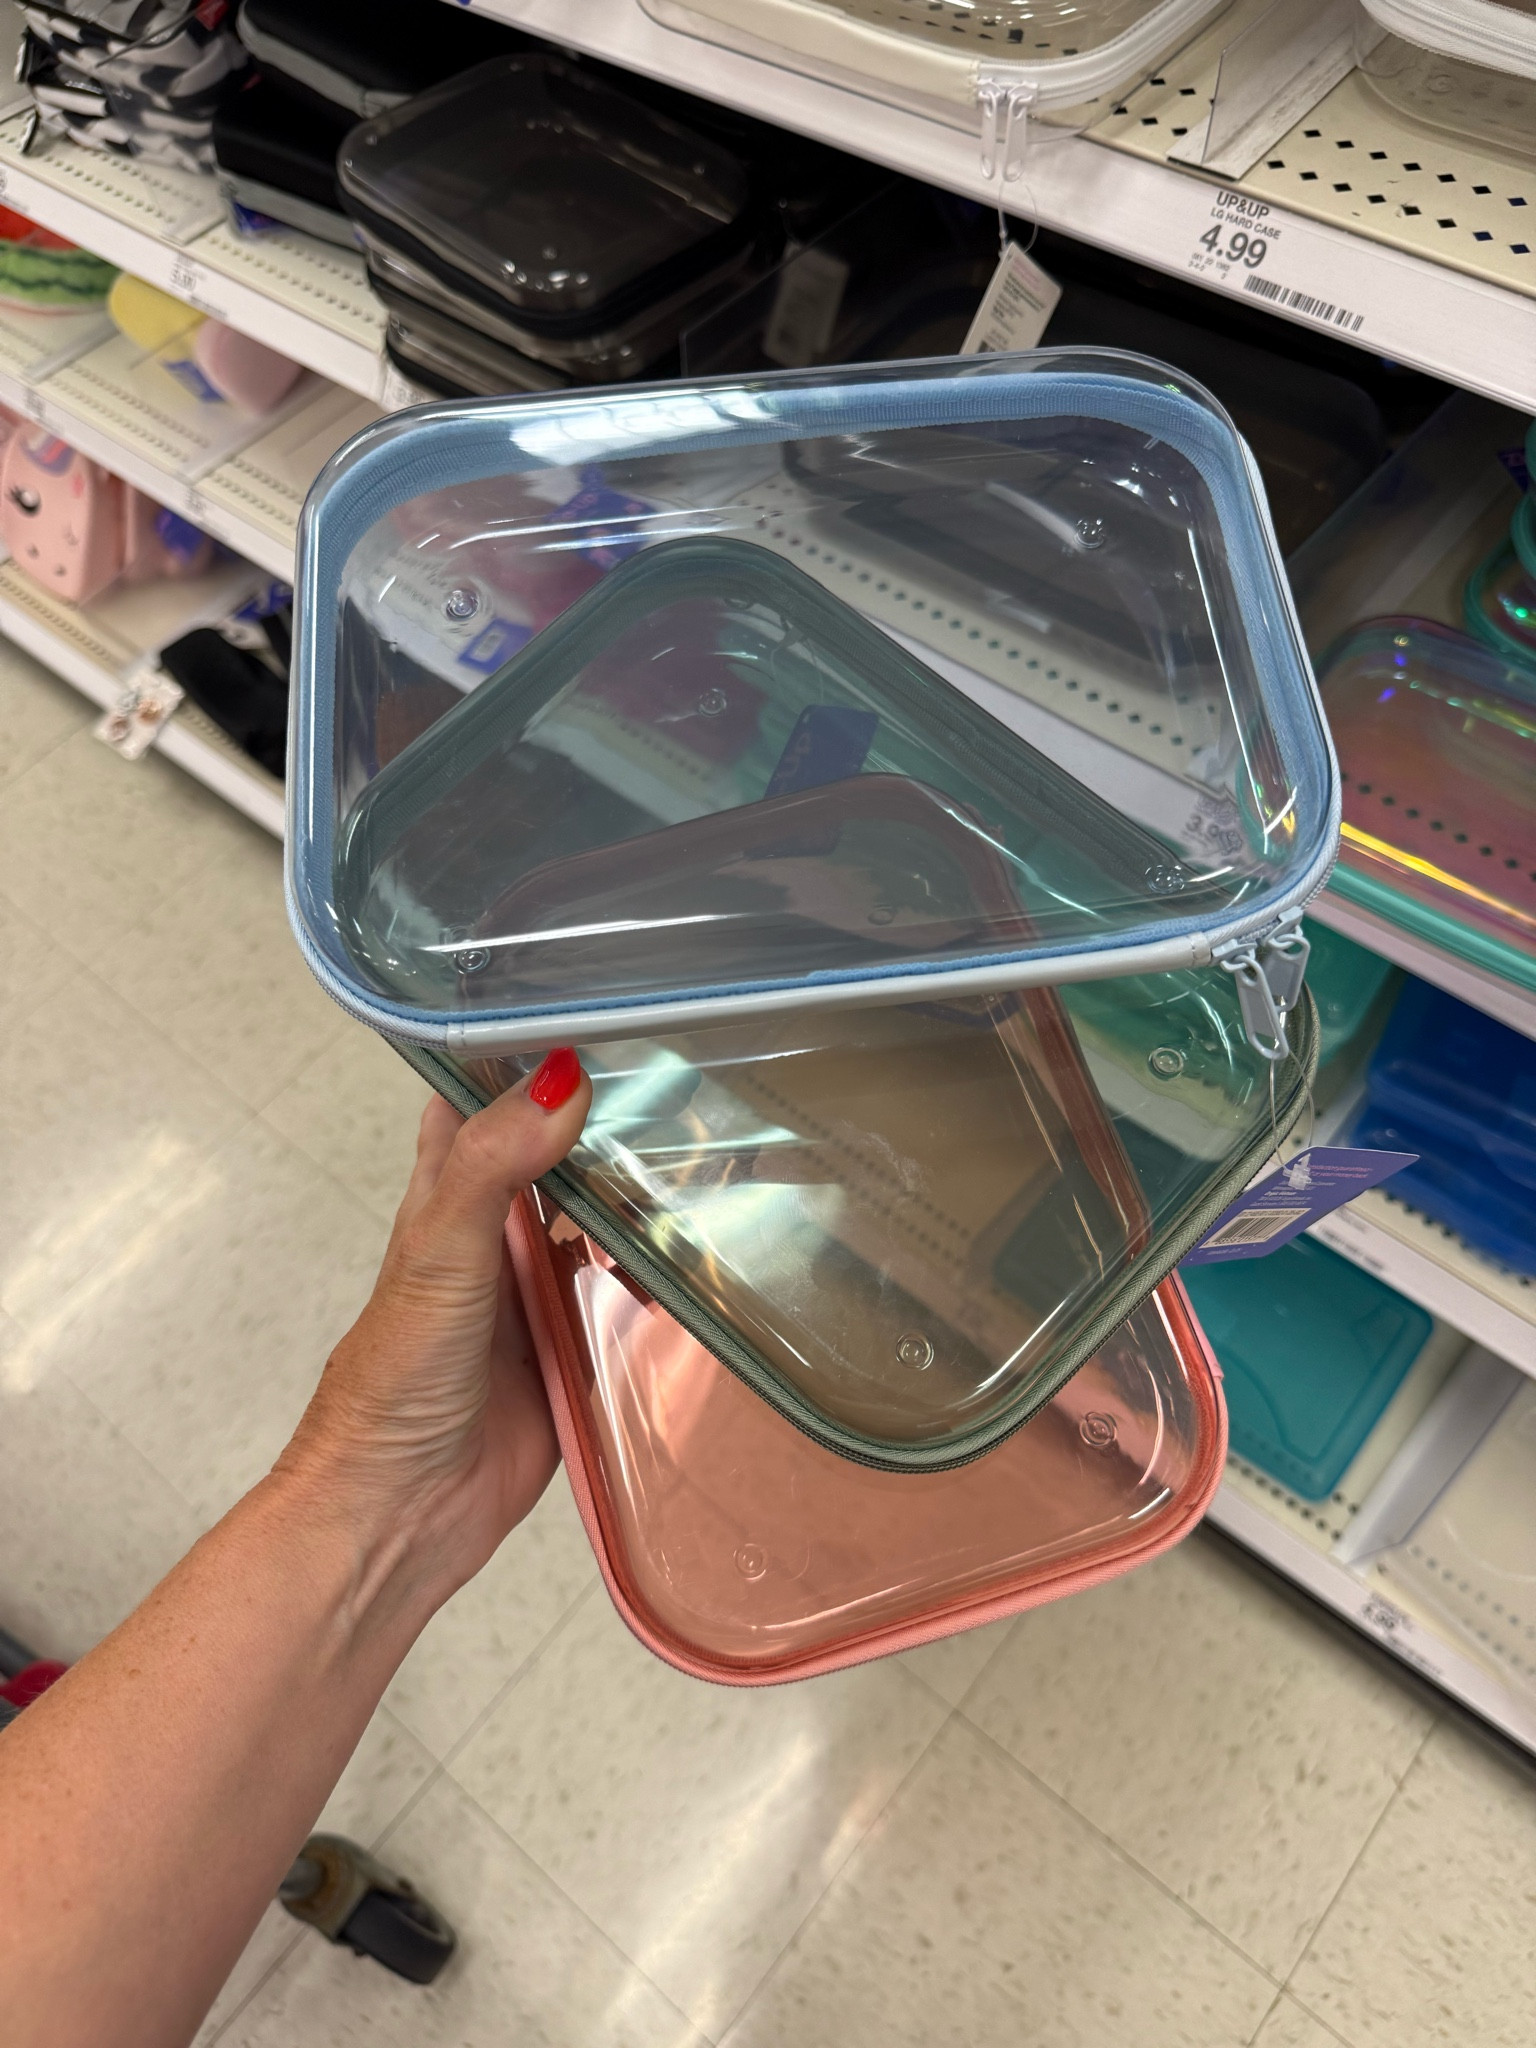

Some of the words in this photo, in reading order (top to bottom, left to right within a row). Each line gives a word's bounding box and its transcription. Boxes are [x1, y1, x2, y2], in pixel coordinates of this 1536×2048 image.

[1216, 191, 1270, 219] UP&UP
[1210, 207, 1225, 220] LG
[1225, 213, 1253, 229] HARD
[1254, 223, 1282, 239] CASE
[1199, 224, 1267, 269] 4.99
